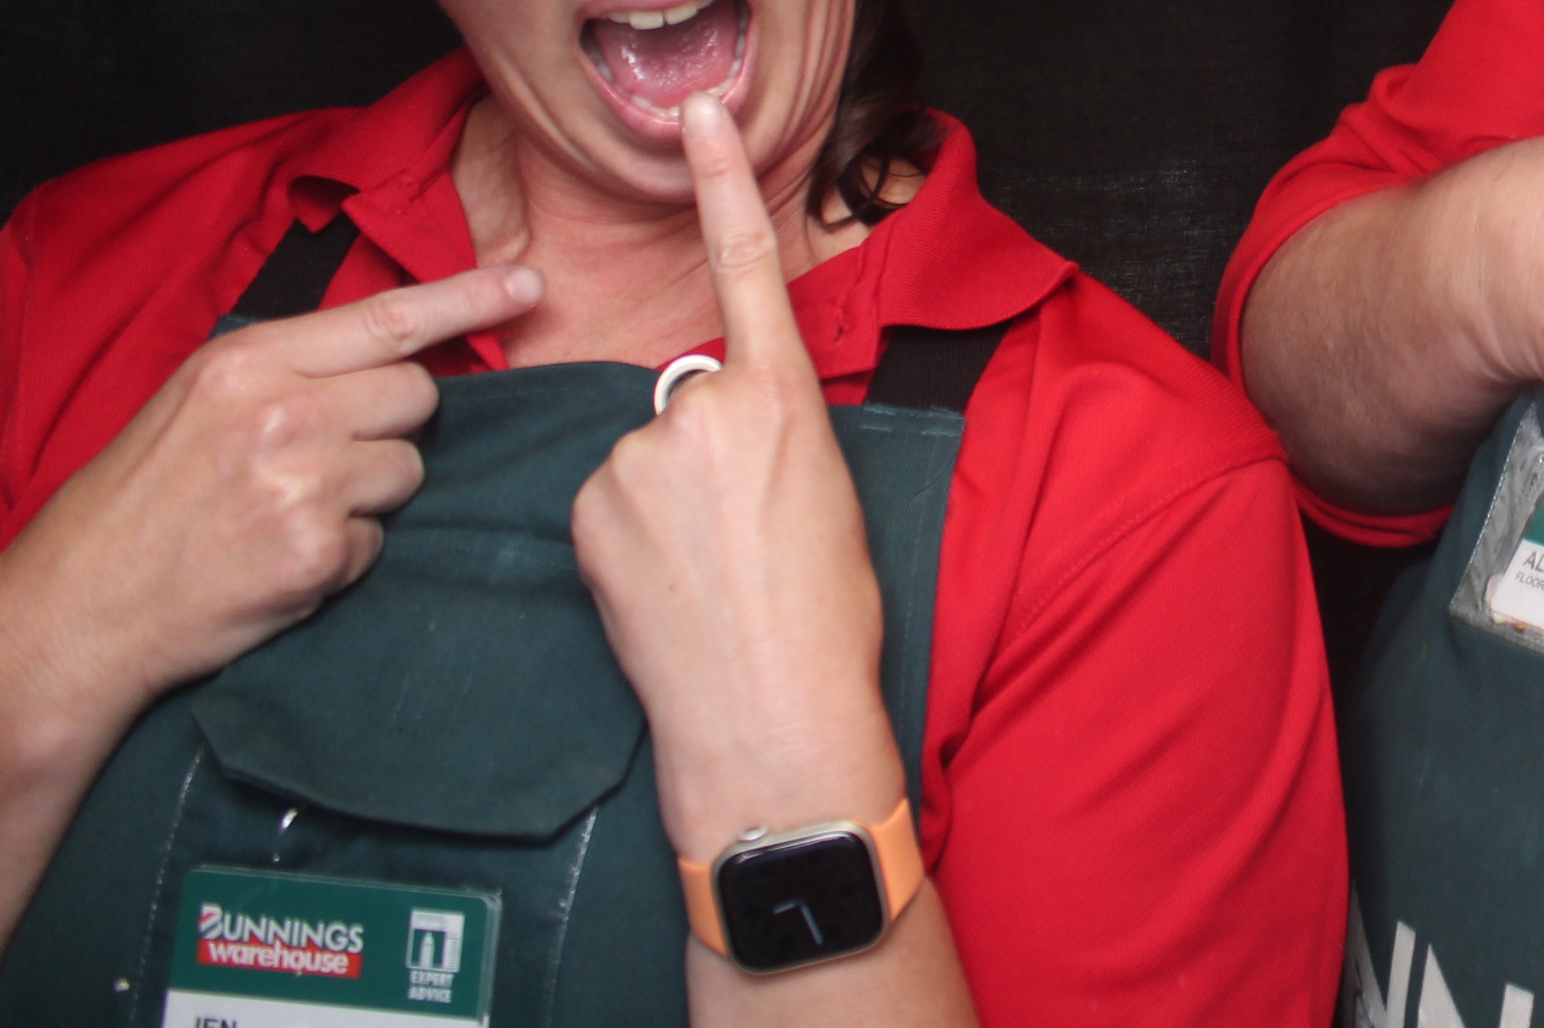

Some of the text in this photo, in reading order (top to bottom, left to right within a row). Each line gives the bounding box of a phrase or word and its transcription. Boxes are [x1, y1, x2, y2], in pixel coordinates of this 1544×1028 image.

[199, 902, 365, 954] BUNNINGS
[208, 939, 350, 975] warehouse
[409, 970, 454, 988] EXPERT
[408, 985, 452, 1004] ADVICE
